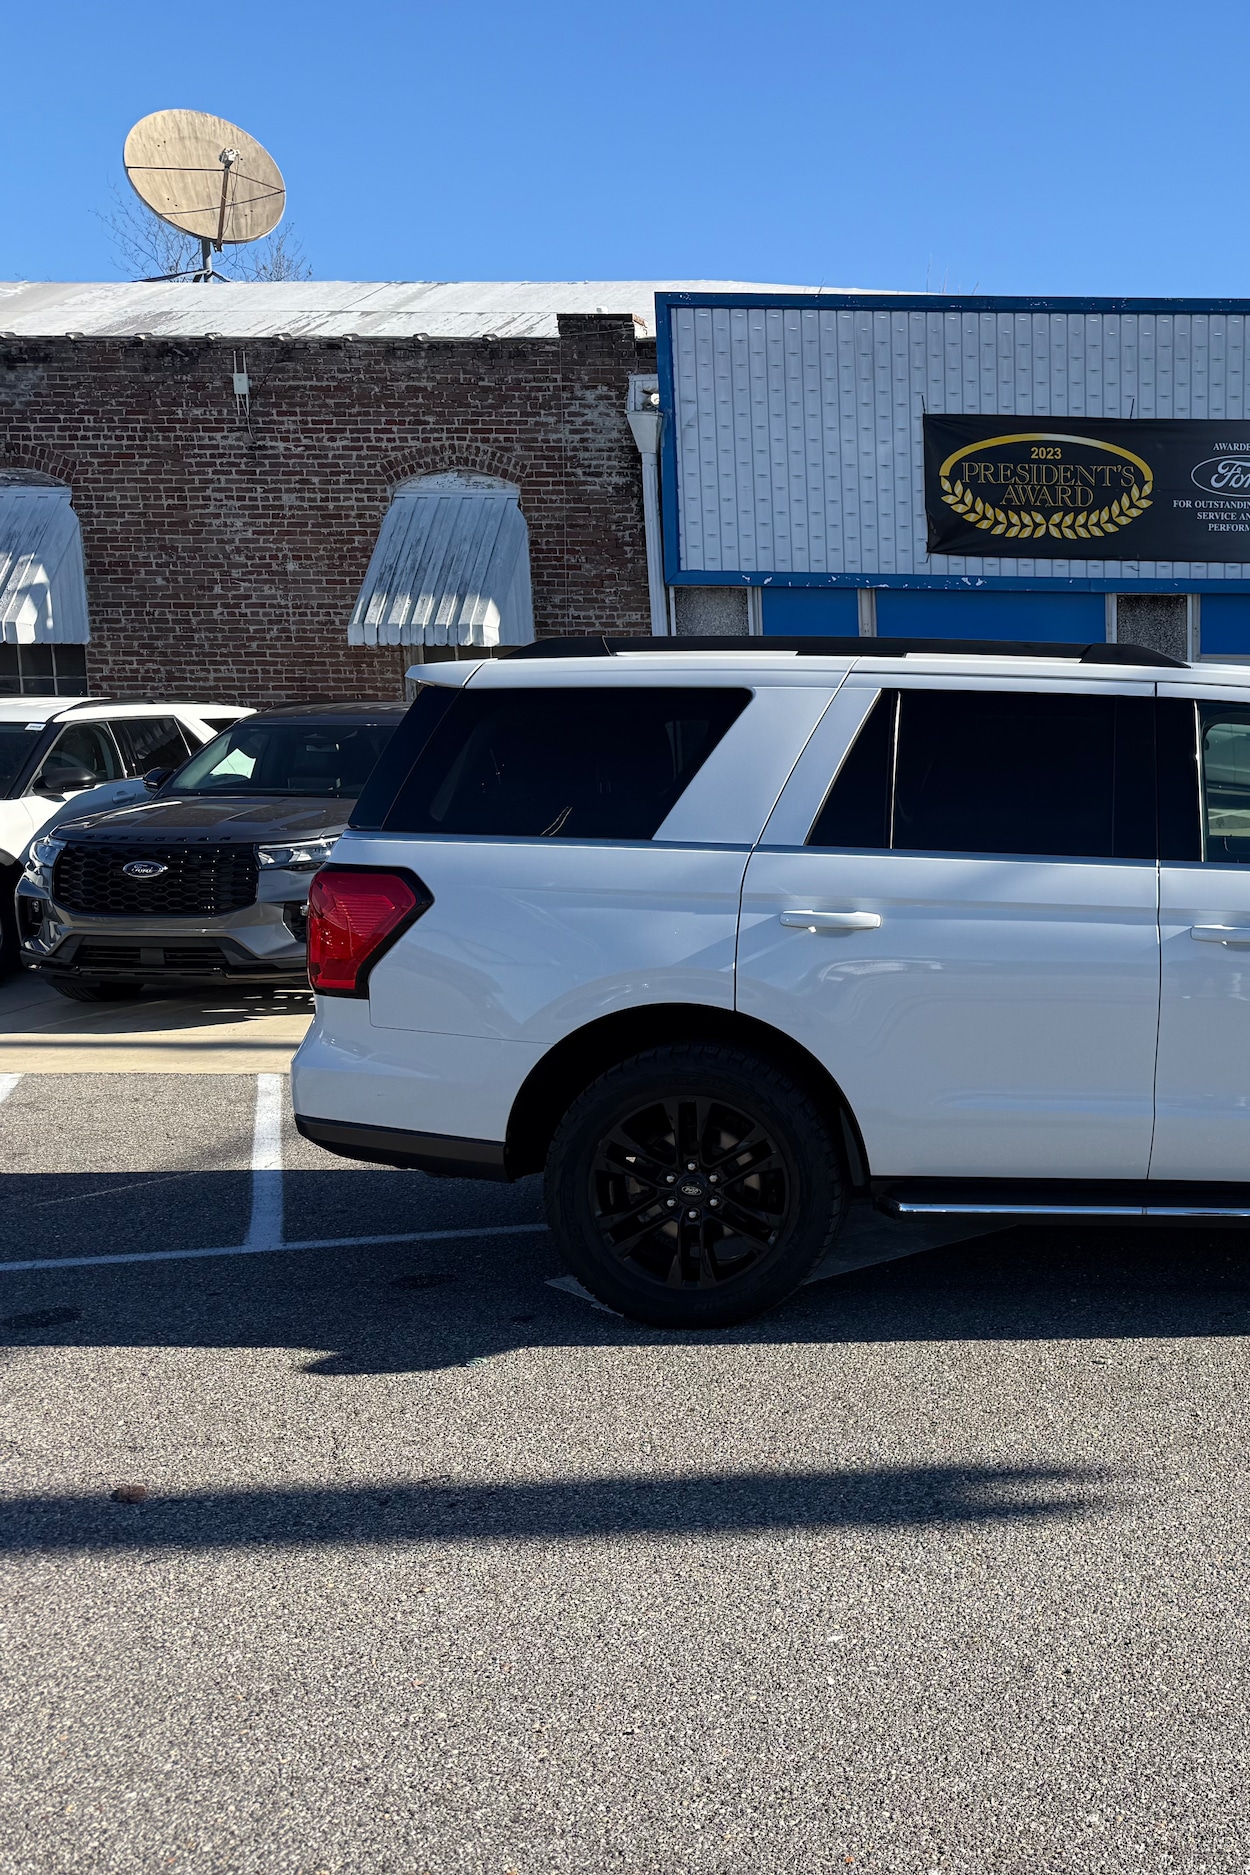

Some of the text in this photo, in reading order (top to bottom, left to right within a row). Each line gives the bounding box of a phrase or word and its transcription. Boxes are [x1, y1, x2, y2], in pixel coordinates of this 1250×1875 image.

[1030, 447, 1062, 460] 2023
[961, 462, 1135, 488] PRESIDENT'S
[999, 484, 1094, 507] AWARD
[1173, 499, 1193, 508] FOR
[1196, 511, 1237, 521] SERVICE
